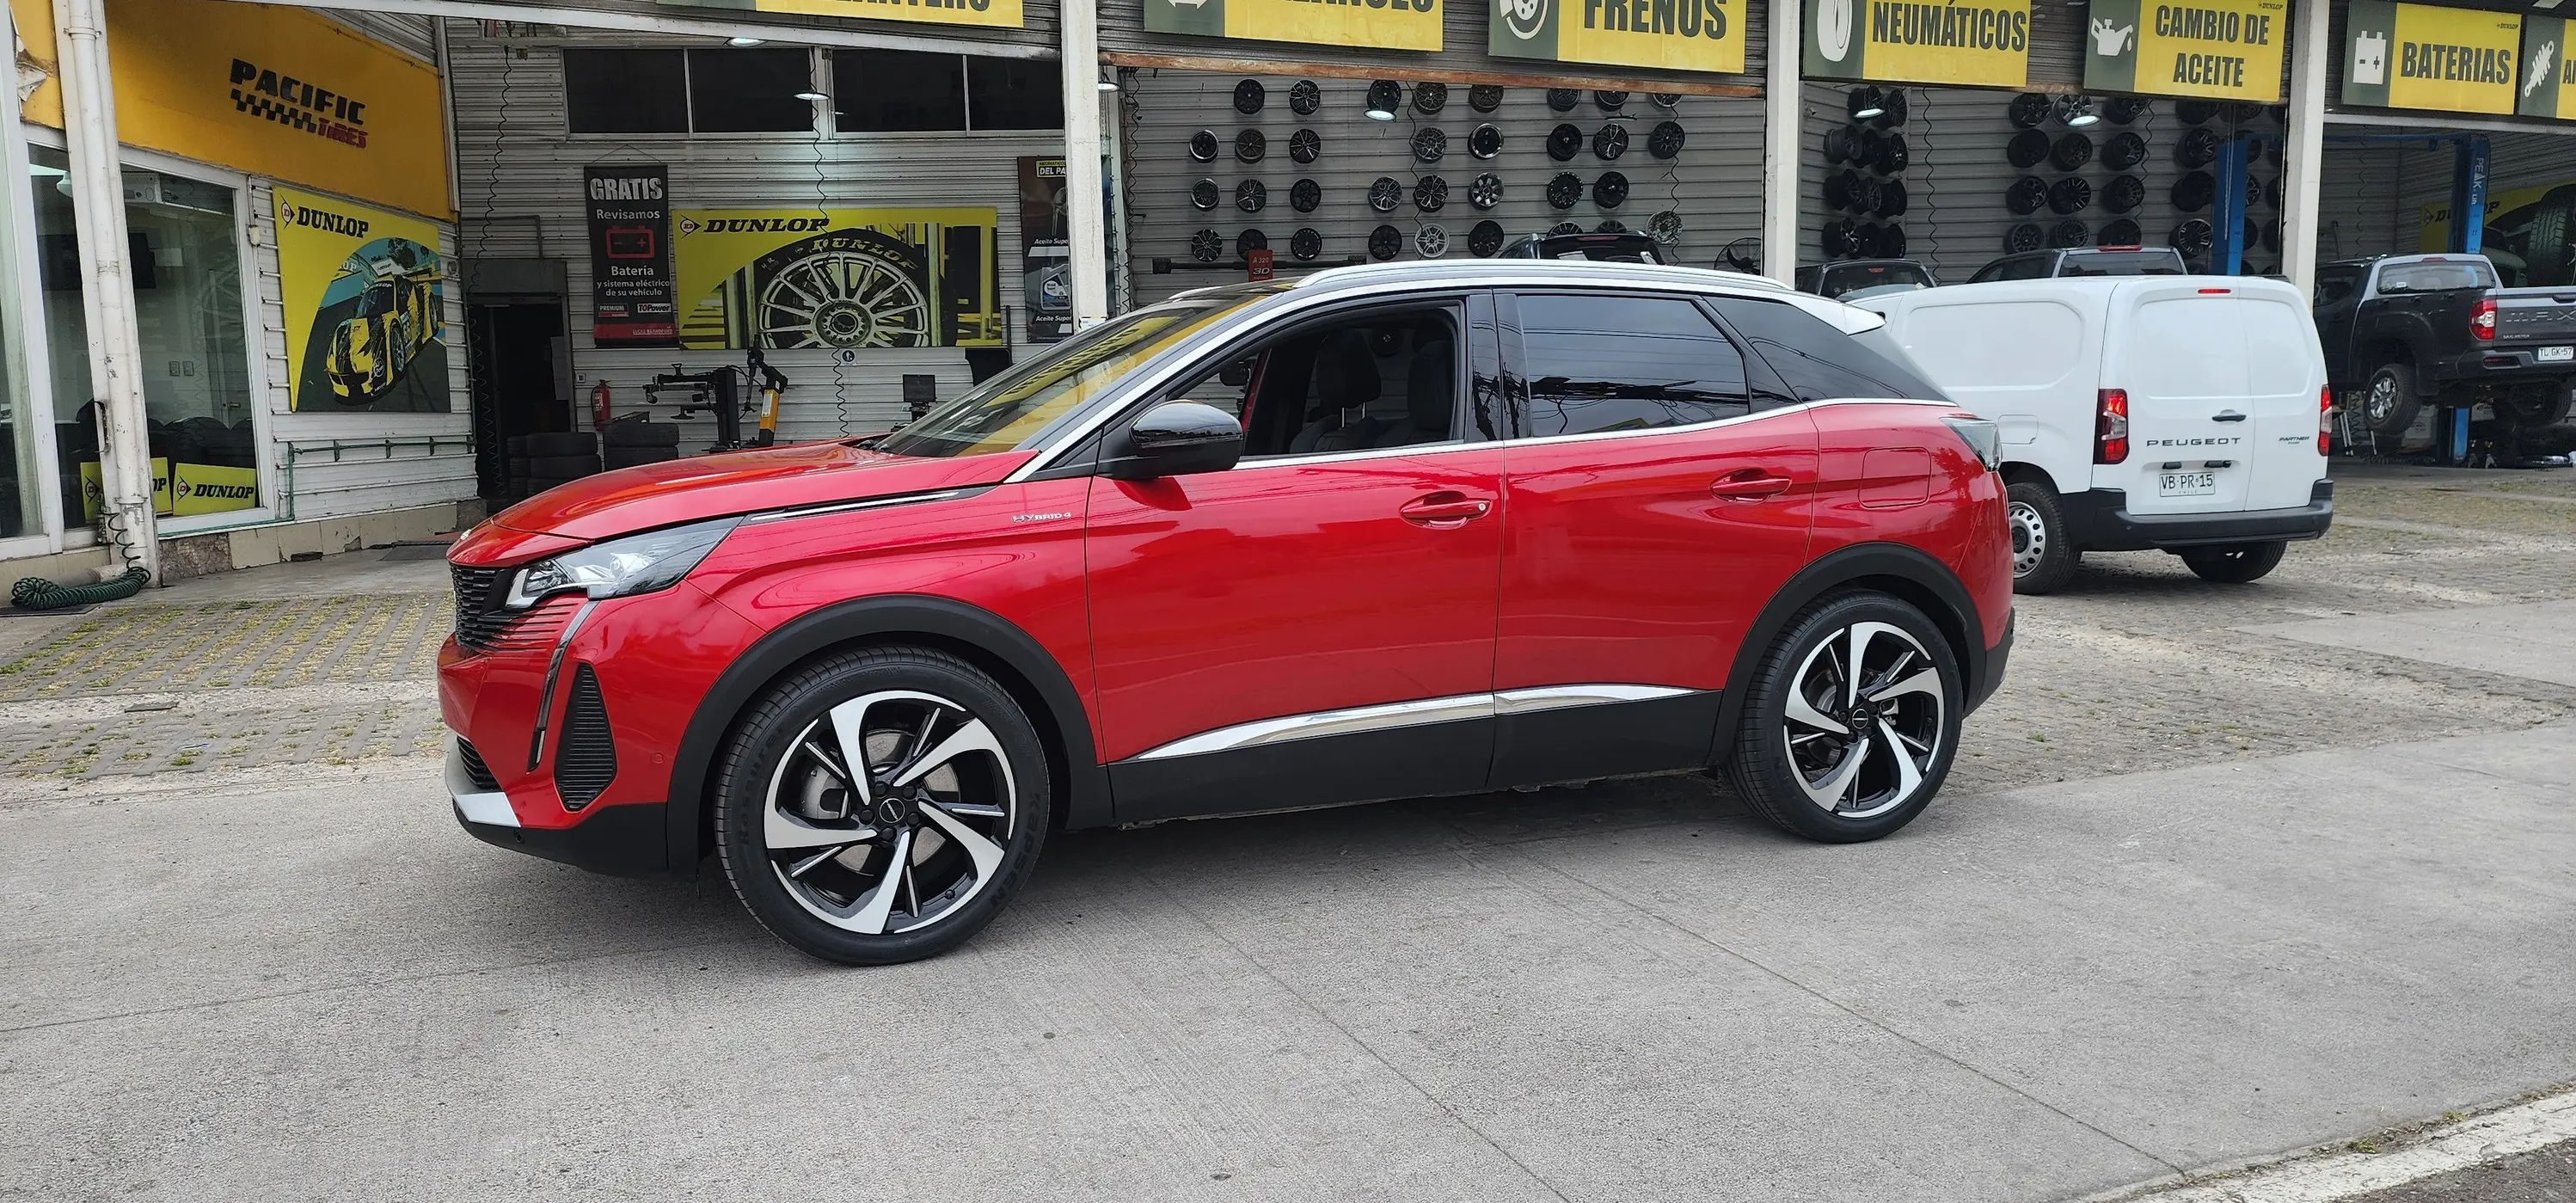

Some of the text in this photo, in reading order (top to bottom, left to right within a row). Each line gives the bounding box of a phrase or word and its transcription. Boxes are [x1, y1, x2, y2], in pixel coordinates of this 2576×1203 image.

[1584, 0, 1727, 40] FRENOS
[1873, 0, 2027, 52] NEUMÁTICOS
[2156, 5, 2270, 45] CAMBIO DE
[2173, 52, 2244, 87] ACEITE
[2401, 42, 2511, 84] BATERIAS
[230, 58, 365, 125] PACIFIC
[318, 117, 368, 149] TIRES
[590, 177, 663, 200] GRATIS
[2473, 157, 2485, 189] PEAK
[297, 206, 369, 238] DUNLOP
[596, 209, 660, 219] Revisamos
[703, 218, 830, 233] DUNLOP
[811, 237, 918, 270] DUNLOP
[611, 265, 654, 275] Batería
[2146, 437, 2241, 446] PEUGEOT
[193, 483, 254, 499] DUNLOP
